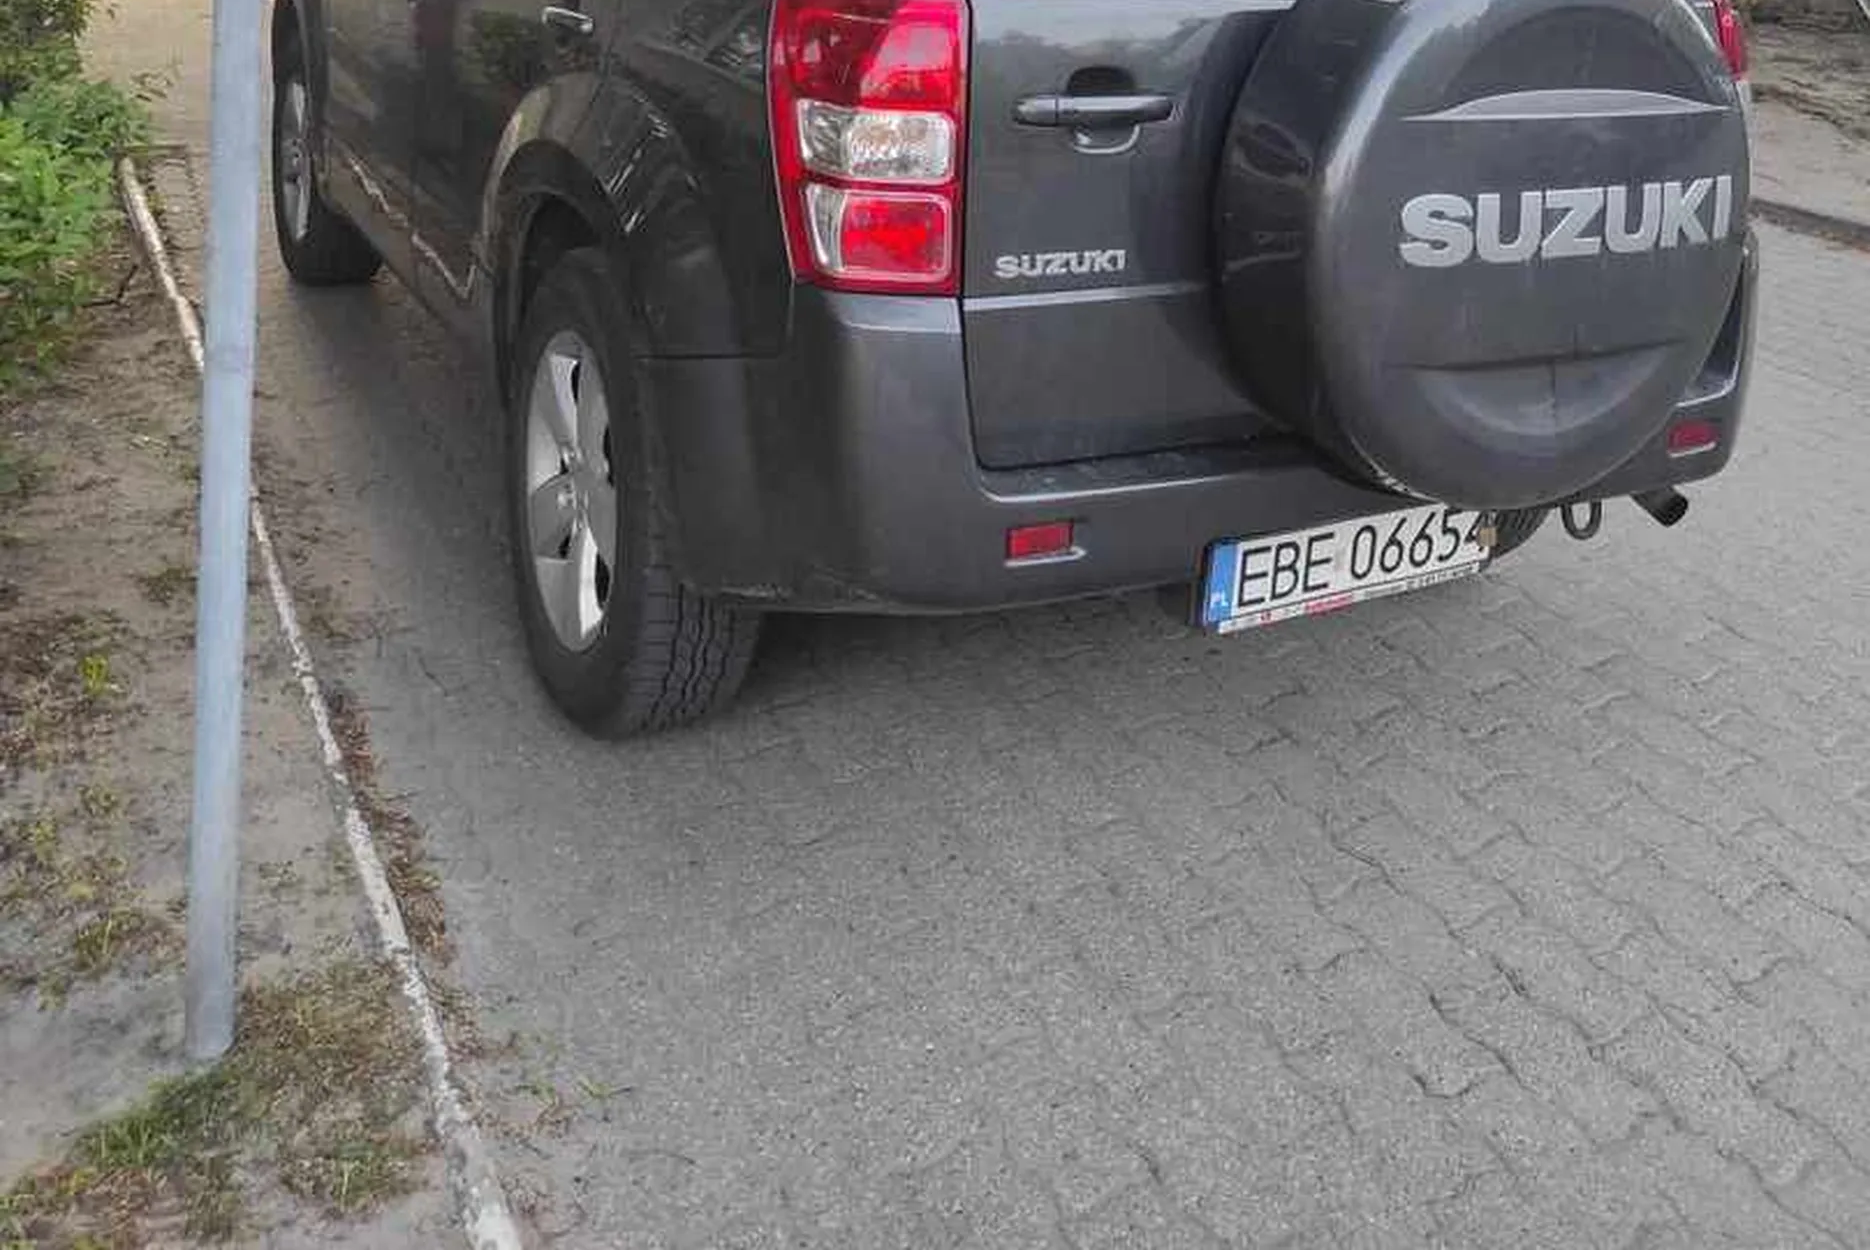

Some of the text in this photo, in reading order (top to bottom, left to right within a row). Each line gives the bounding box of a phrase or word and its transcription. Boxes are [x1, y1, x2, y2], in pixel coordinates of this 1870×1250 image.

[1400, 175, 1732, 266] SUZUKI
[994, 249, 1126, 278] SUZUKI
[1238, 531, 1334, 607] EBE
